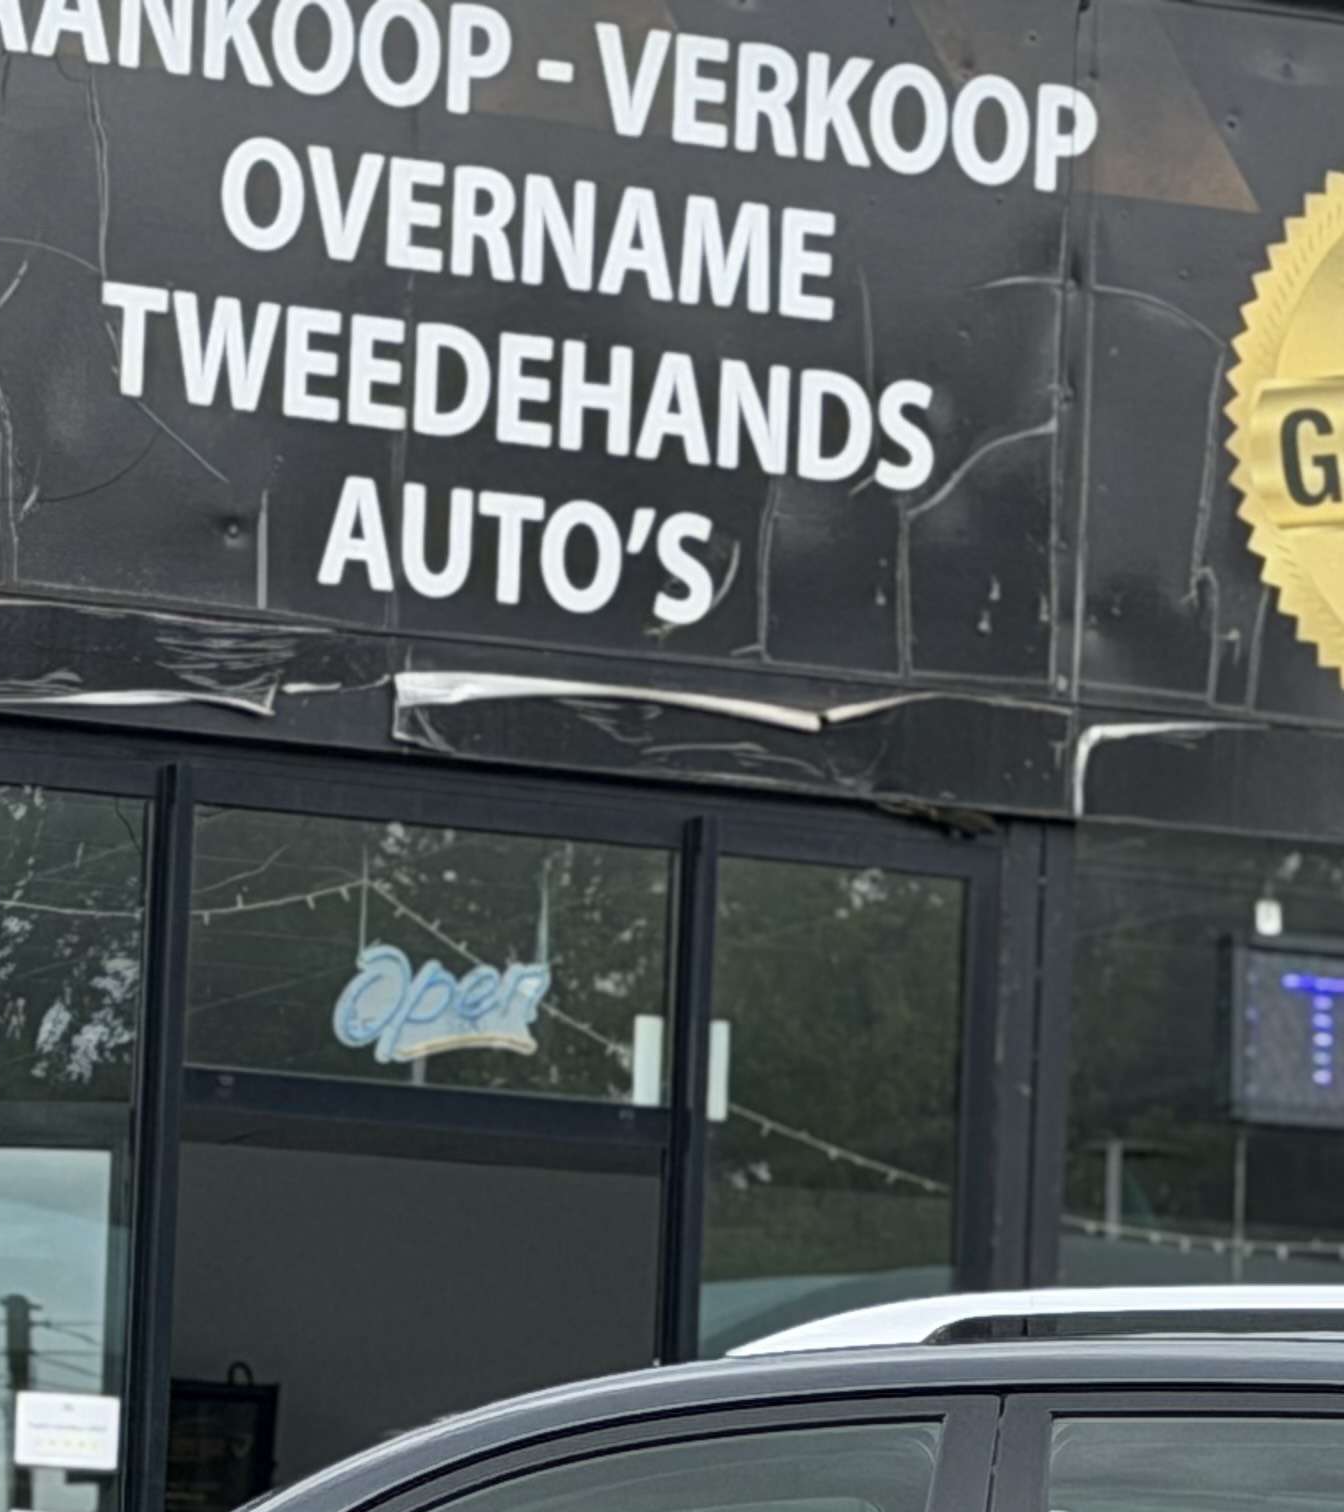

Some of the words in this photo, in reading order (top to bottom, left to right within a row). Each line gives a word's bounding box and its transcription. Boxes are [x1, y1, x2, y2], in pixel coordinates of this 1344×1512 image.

[595, 21, 1099, 193] VERKOOP
[221, 136, 837, 321] OVERNAME
[102, 281, 935, 492] TWEEDEHANDS
[317, 475, 716, 627] AUTO'S
[334, 945, 551, 1063] Open
